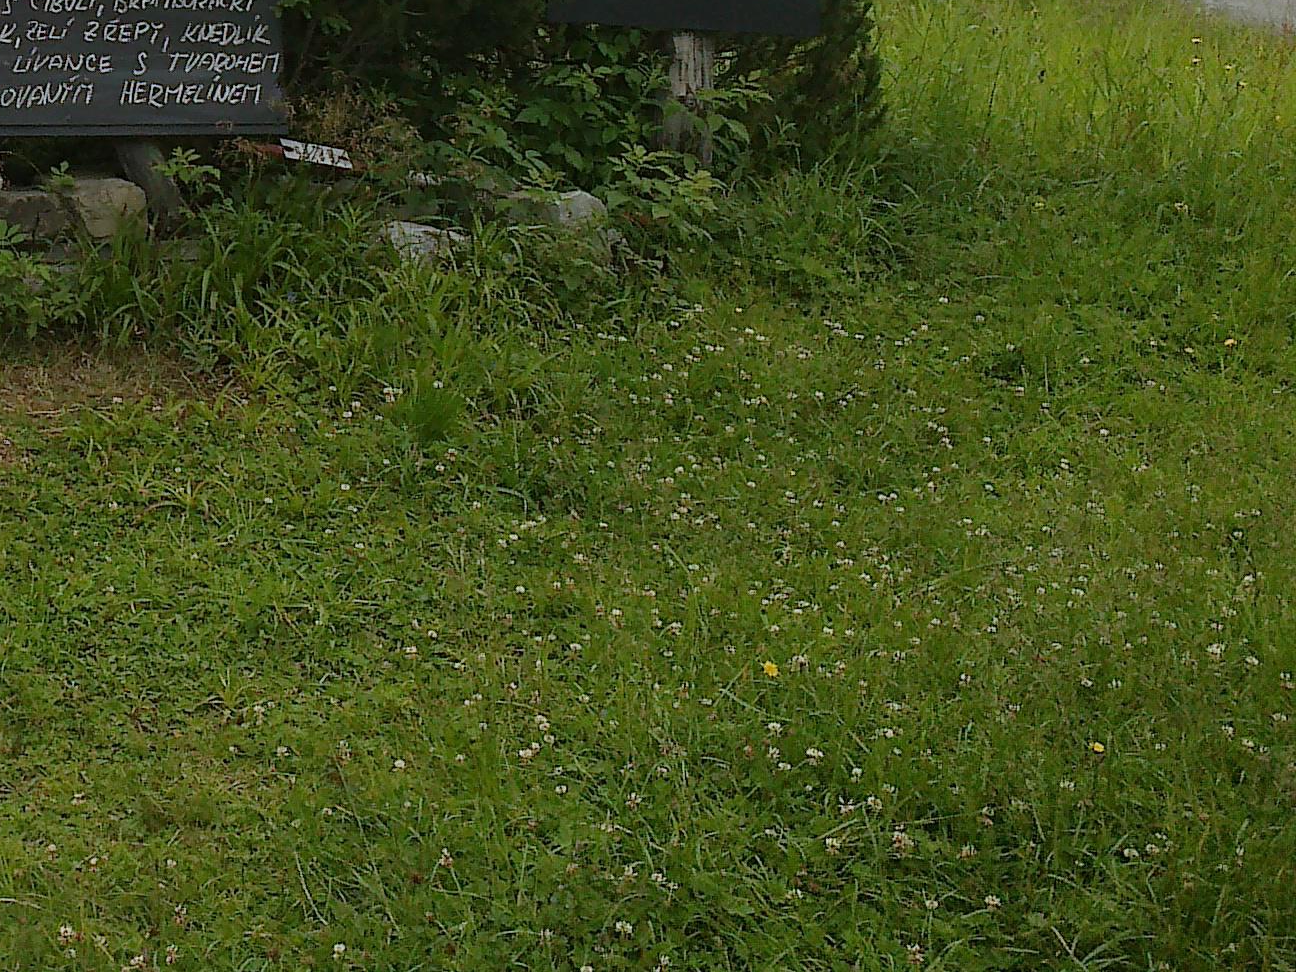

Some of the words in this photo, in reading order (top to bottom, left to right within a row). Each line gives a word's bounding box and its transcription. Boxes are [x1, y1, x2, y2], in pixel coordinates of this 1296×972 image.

[13, 47, 113, 74] LÍVANCE
[132, 51, 148, 75] S
[120, 75, 262, 108] HERMELÍNEM
